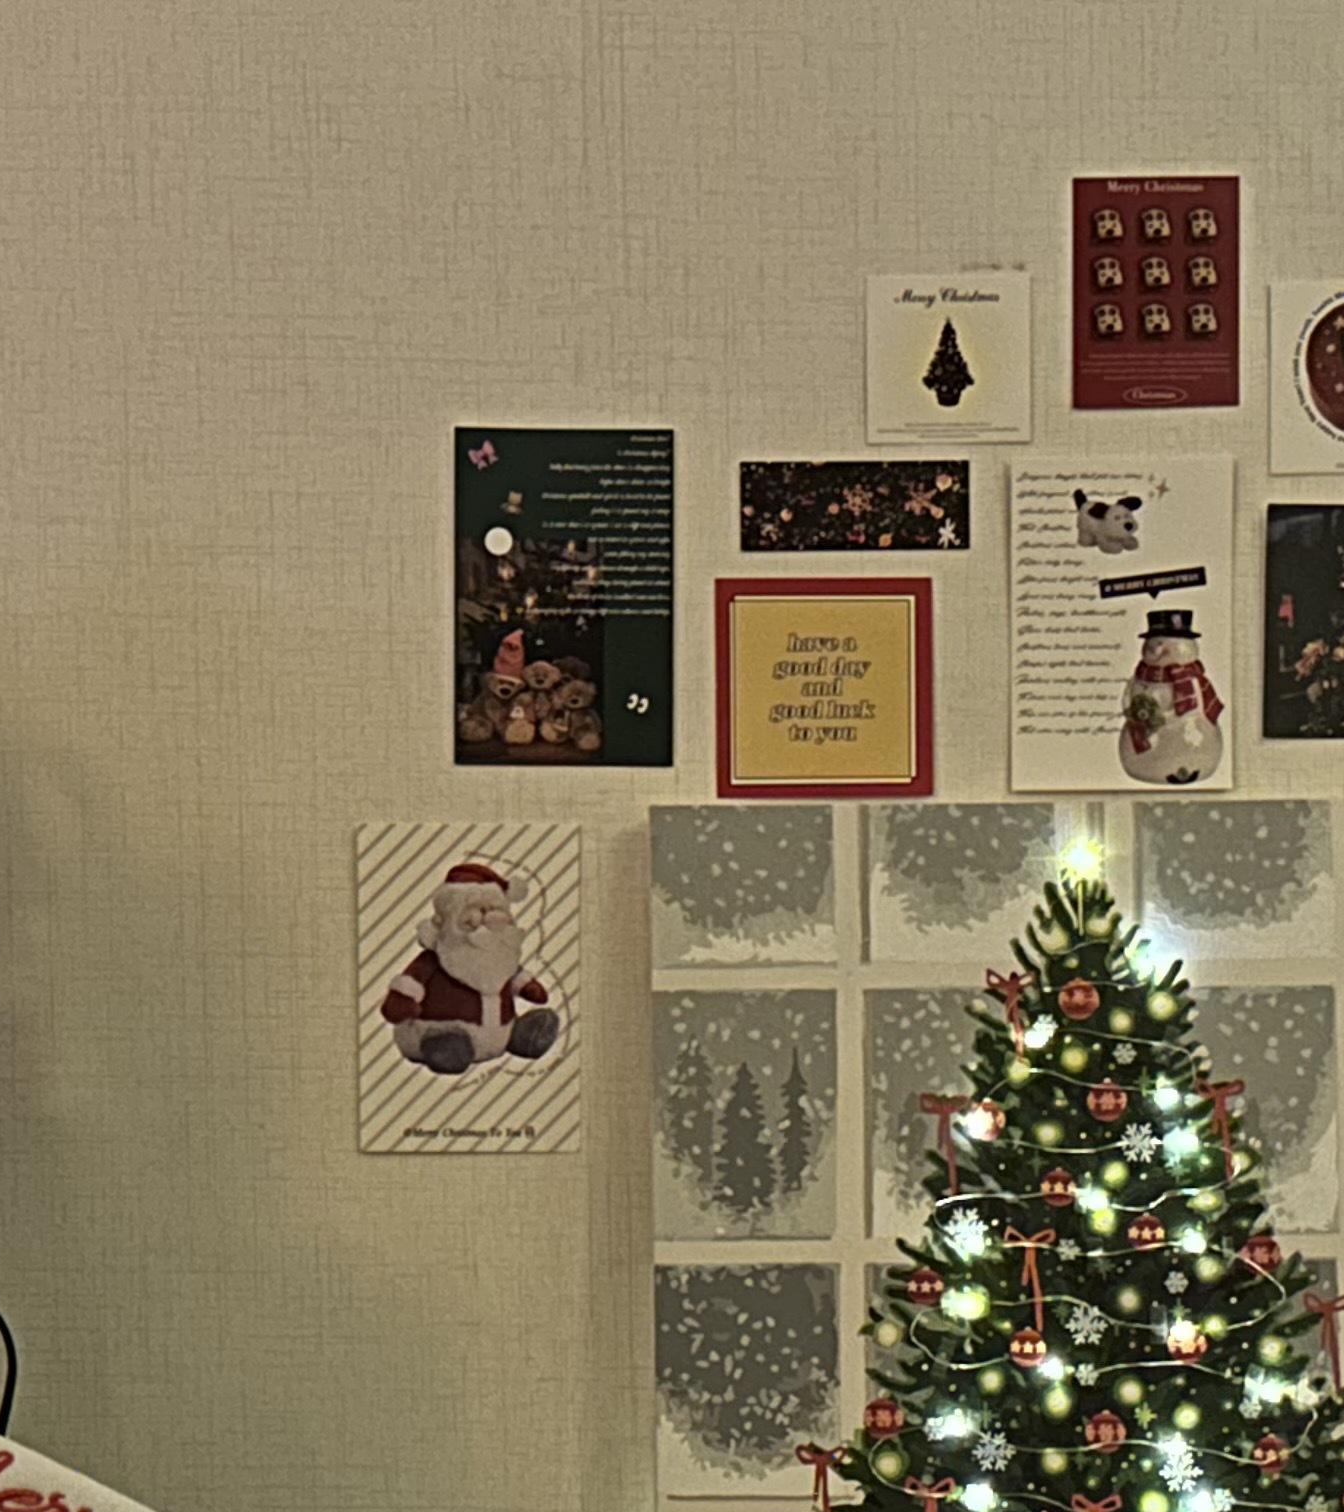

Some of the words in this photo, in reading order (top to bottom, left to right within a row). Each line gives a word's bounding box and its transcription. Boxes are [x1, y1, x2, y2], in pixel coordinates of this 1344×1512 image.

[1107, 181, 1140, 195] Merry
[1144, 180, 1204, 193] Christmas
[786, 633, 839, 653] have
[842, 637, 857, 653] a
[772, 658, 827, 680] good
[830, 658, 871, 679] day
[801, 678, 843, 697] and
[769, 700, 823, 723] good
[826, 701, 876, 719] luck
[788, 724, 813, 742] to
[815, 726, 858, 745] you
